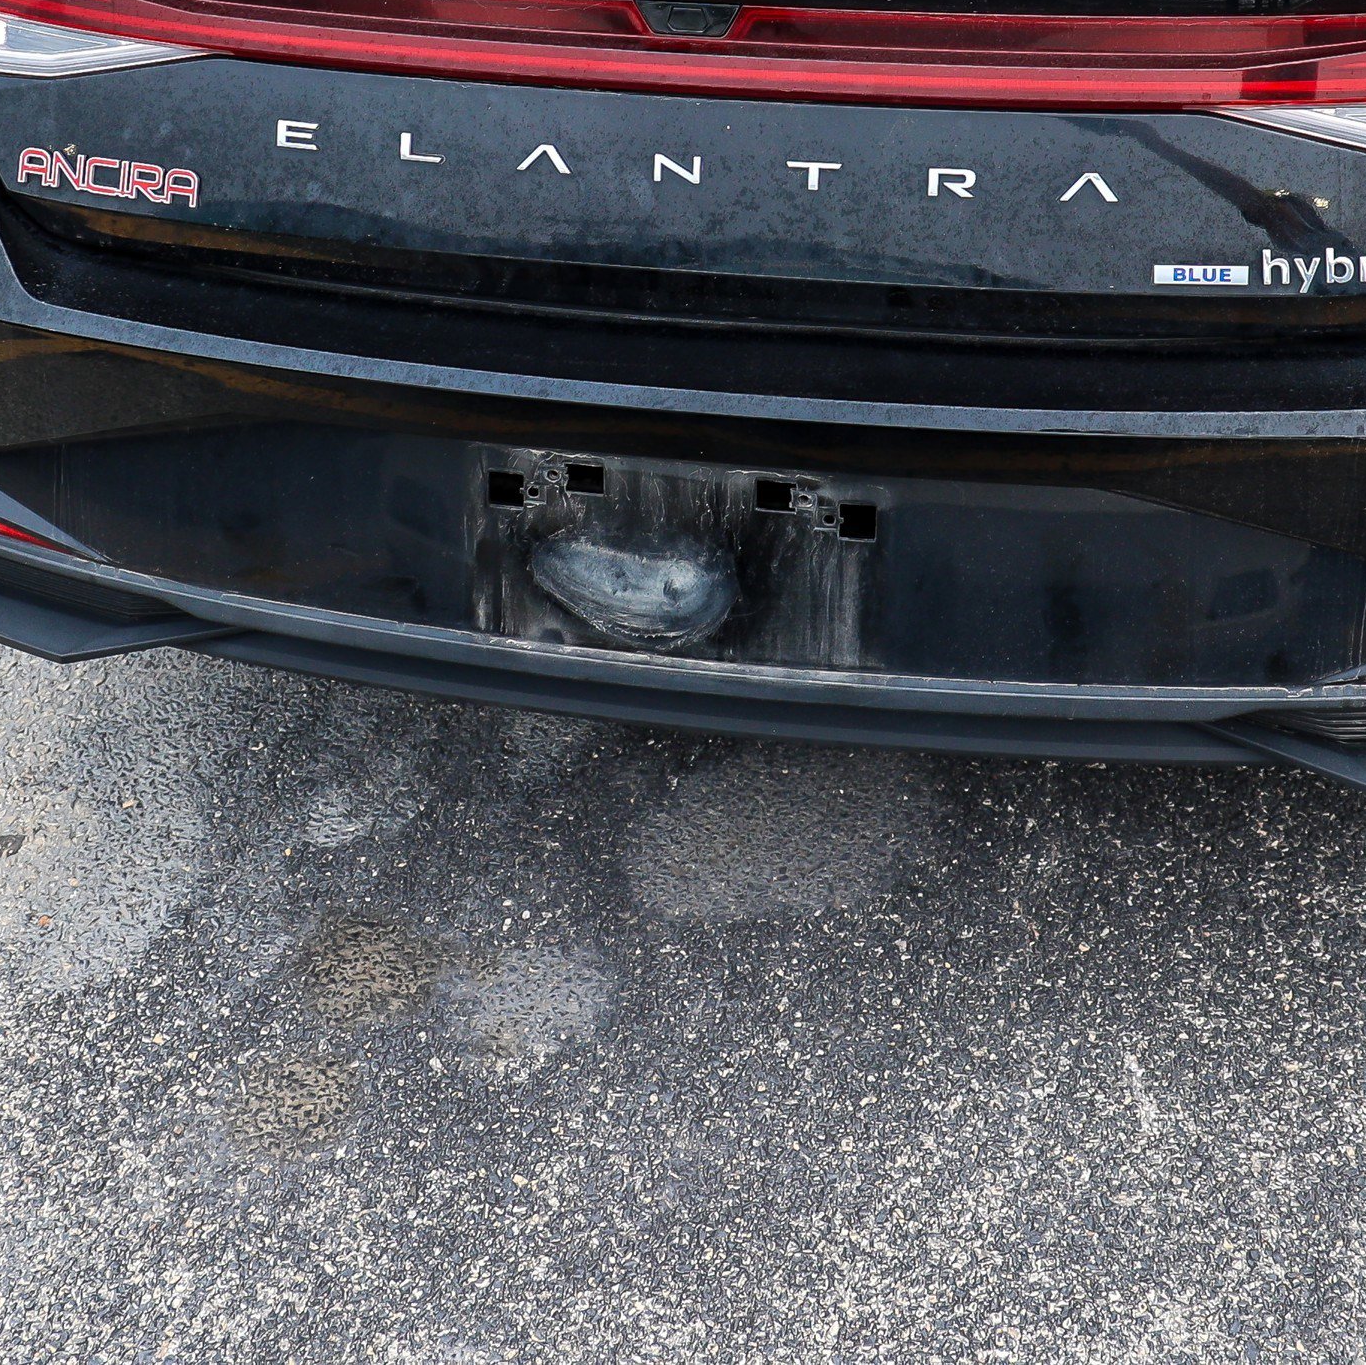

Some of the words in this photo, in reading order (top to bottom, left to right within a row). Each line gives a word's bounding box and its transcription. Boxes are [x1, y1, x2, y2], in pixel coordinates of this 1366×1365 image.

[17, 147, 200, 208] ANCIRA
[276, 119, 1119, 203] ELANTRA
[1172, 267, 1232, 283] BLUE
